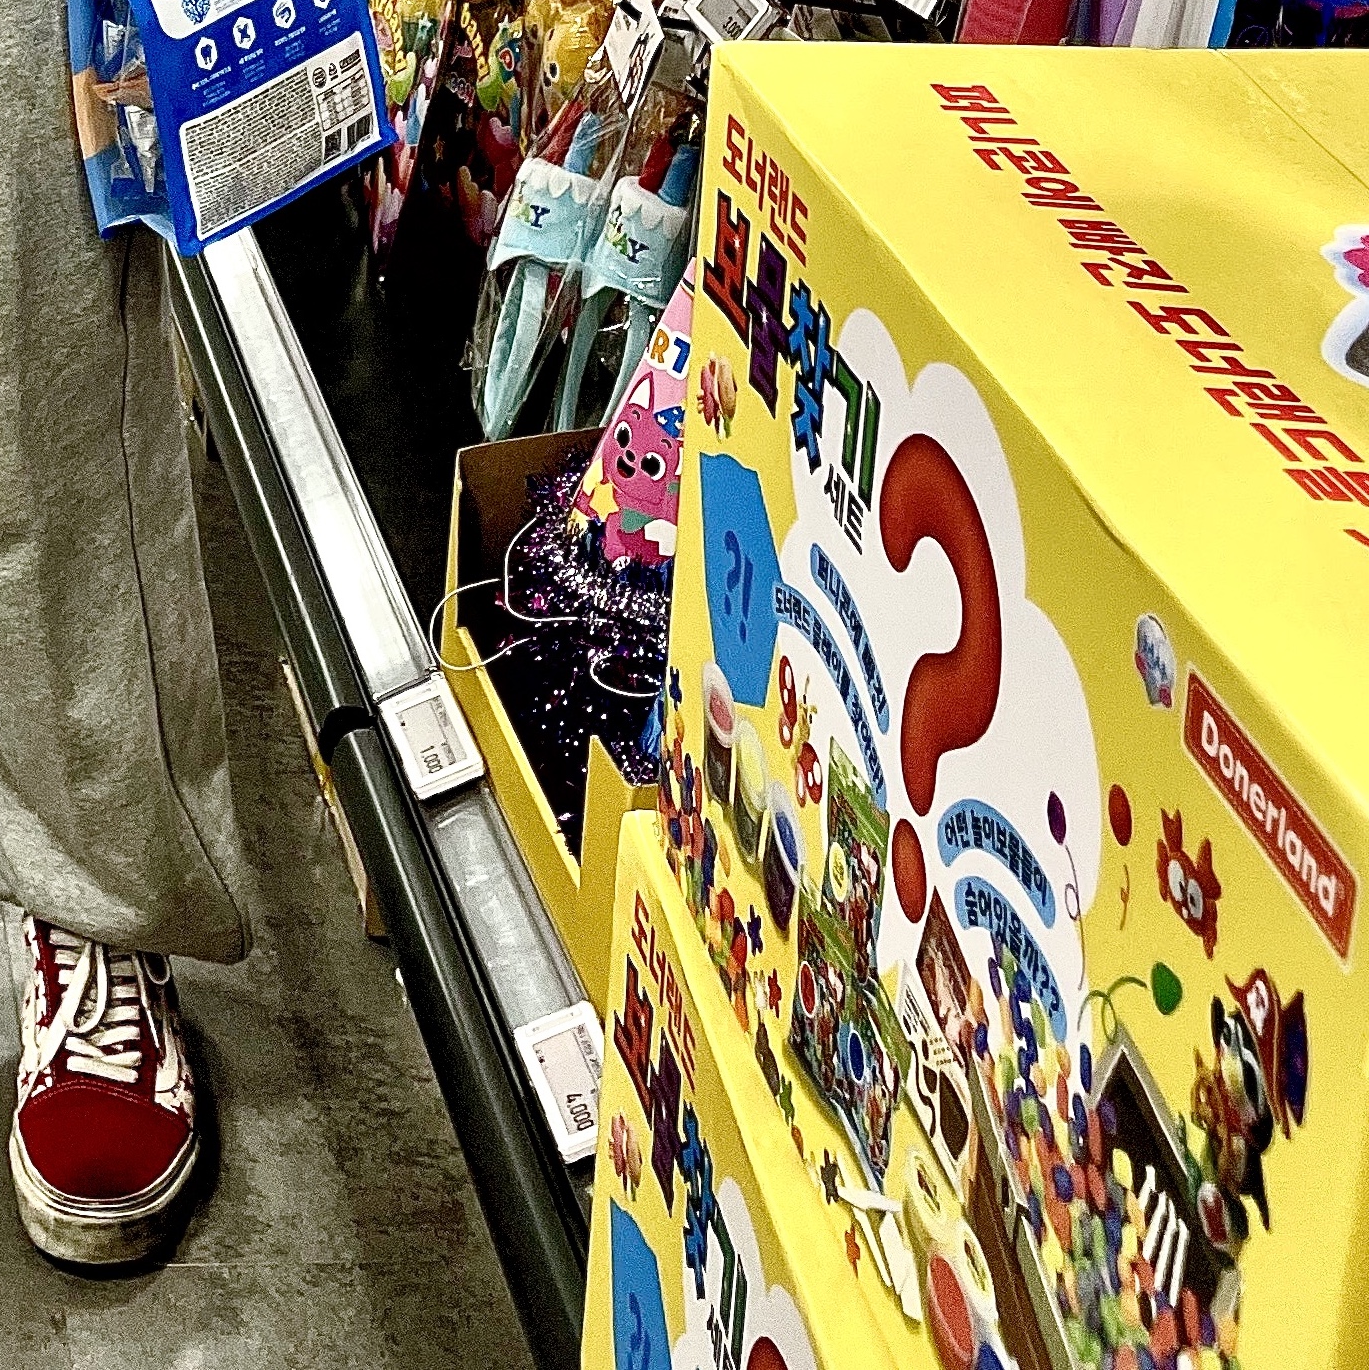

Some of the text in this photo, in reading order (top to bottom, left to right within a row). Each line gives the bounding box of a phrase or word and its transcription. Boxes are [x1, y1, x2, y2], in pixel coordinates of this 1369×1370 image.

[721, 113, 810, 268] 도너랜드
[929, 82, 1105, 213] 퍼니콘에
[1058, 217, 1190, 295] 빠진
[702, 189, 882, 513] 보물찾기
[823, 461, 865, 557] 세트
[1198, 707, 1341, 919] Donerland
